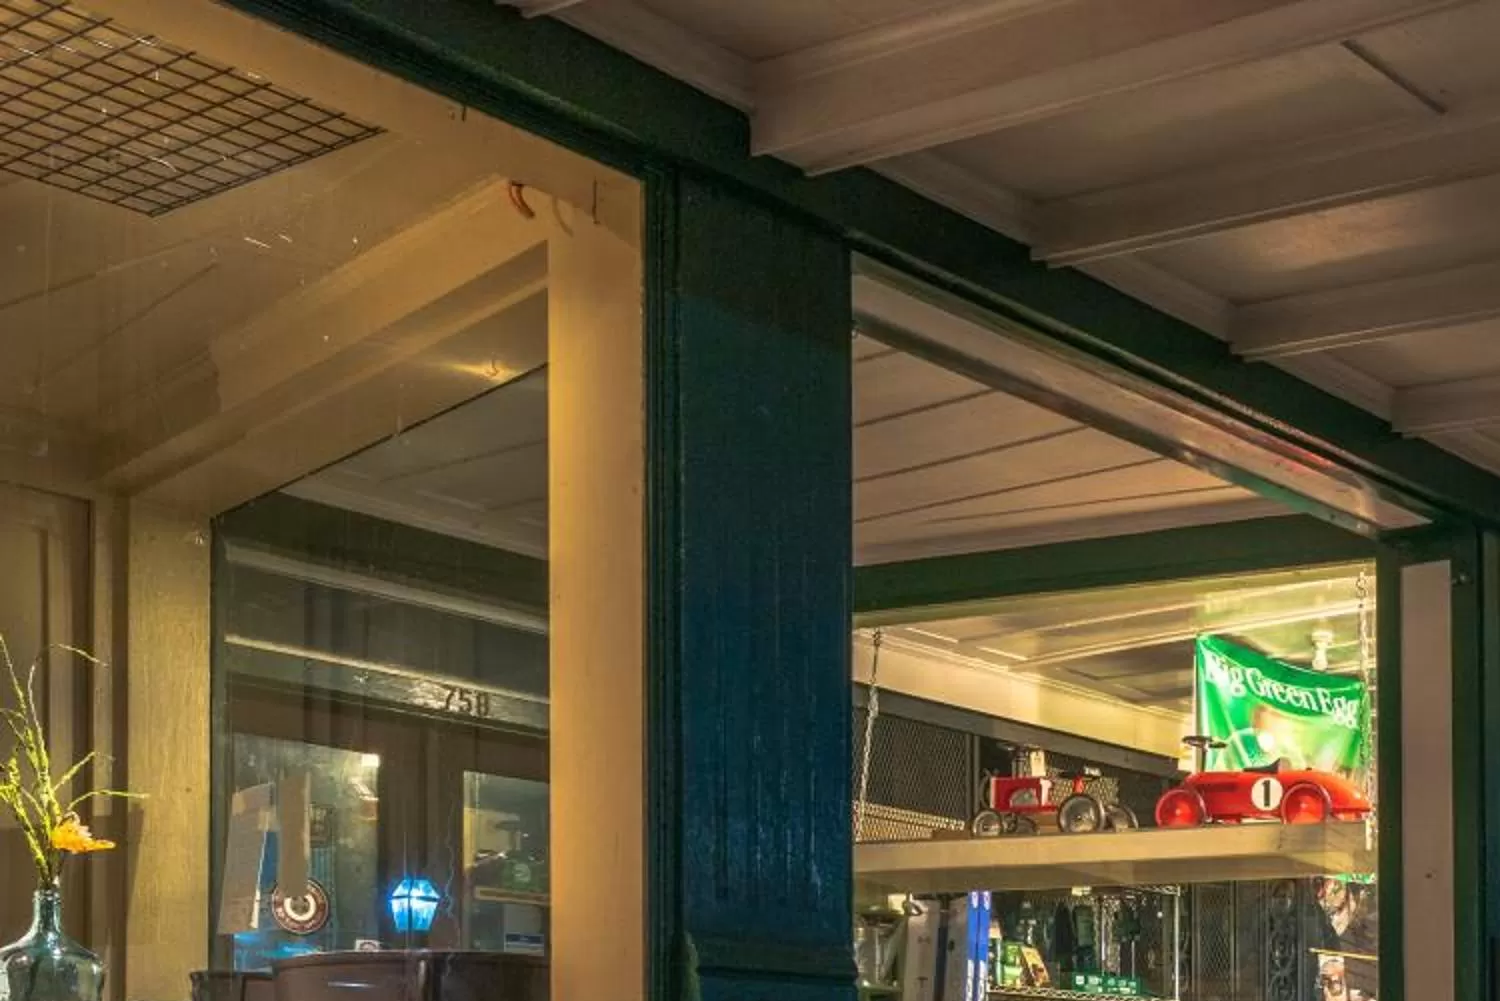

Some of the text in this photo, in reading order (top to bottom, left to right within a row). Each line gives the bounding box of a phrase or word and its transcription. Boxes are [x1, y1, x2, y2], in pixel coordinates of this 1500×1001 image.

[1246, 668, 1319, 712] Green
[1316, 688, 1359, 728] Egg
[1262, 779, 1271, 807] 1
